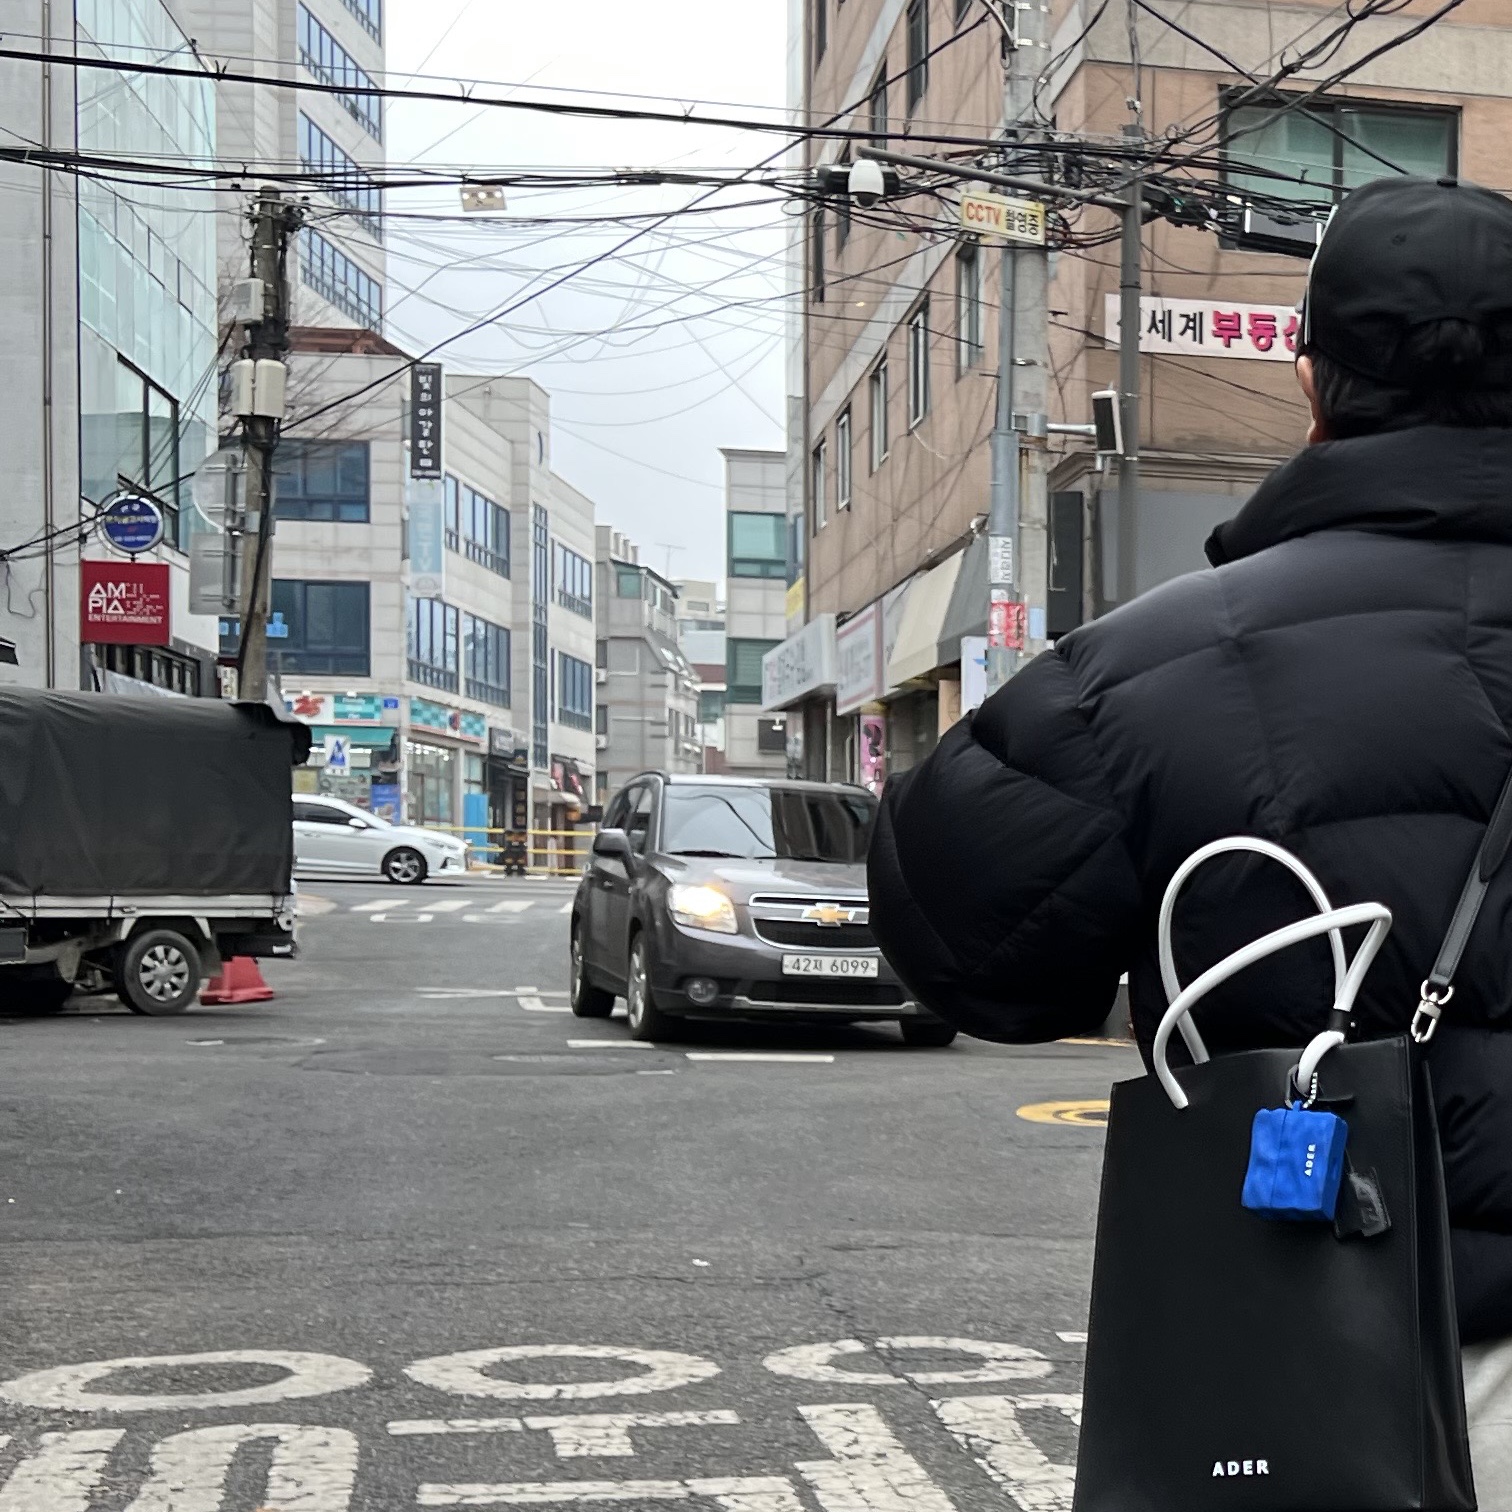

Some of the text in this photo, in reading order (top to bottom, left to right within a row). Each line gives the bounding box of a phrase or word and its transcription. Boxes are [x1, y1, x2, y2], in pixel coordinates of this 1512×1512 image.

[966, 202, 1002, 226] CCTV
[830, 958, 870, 974] 6099
[1304, 1144, 1316, 1177] ADER
[1212, 1459, 1270, 1477] ADER
